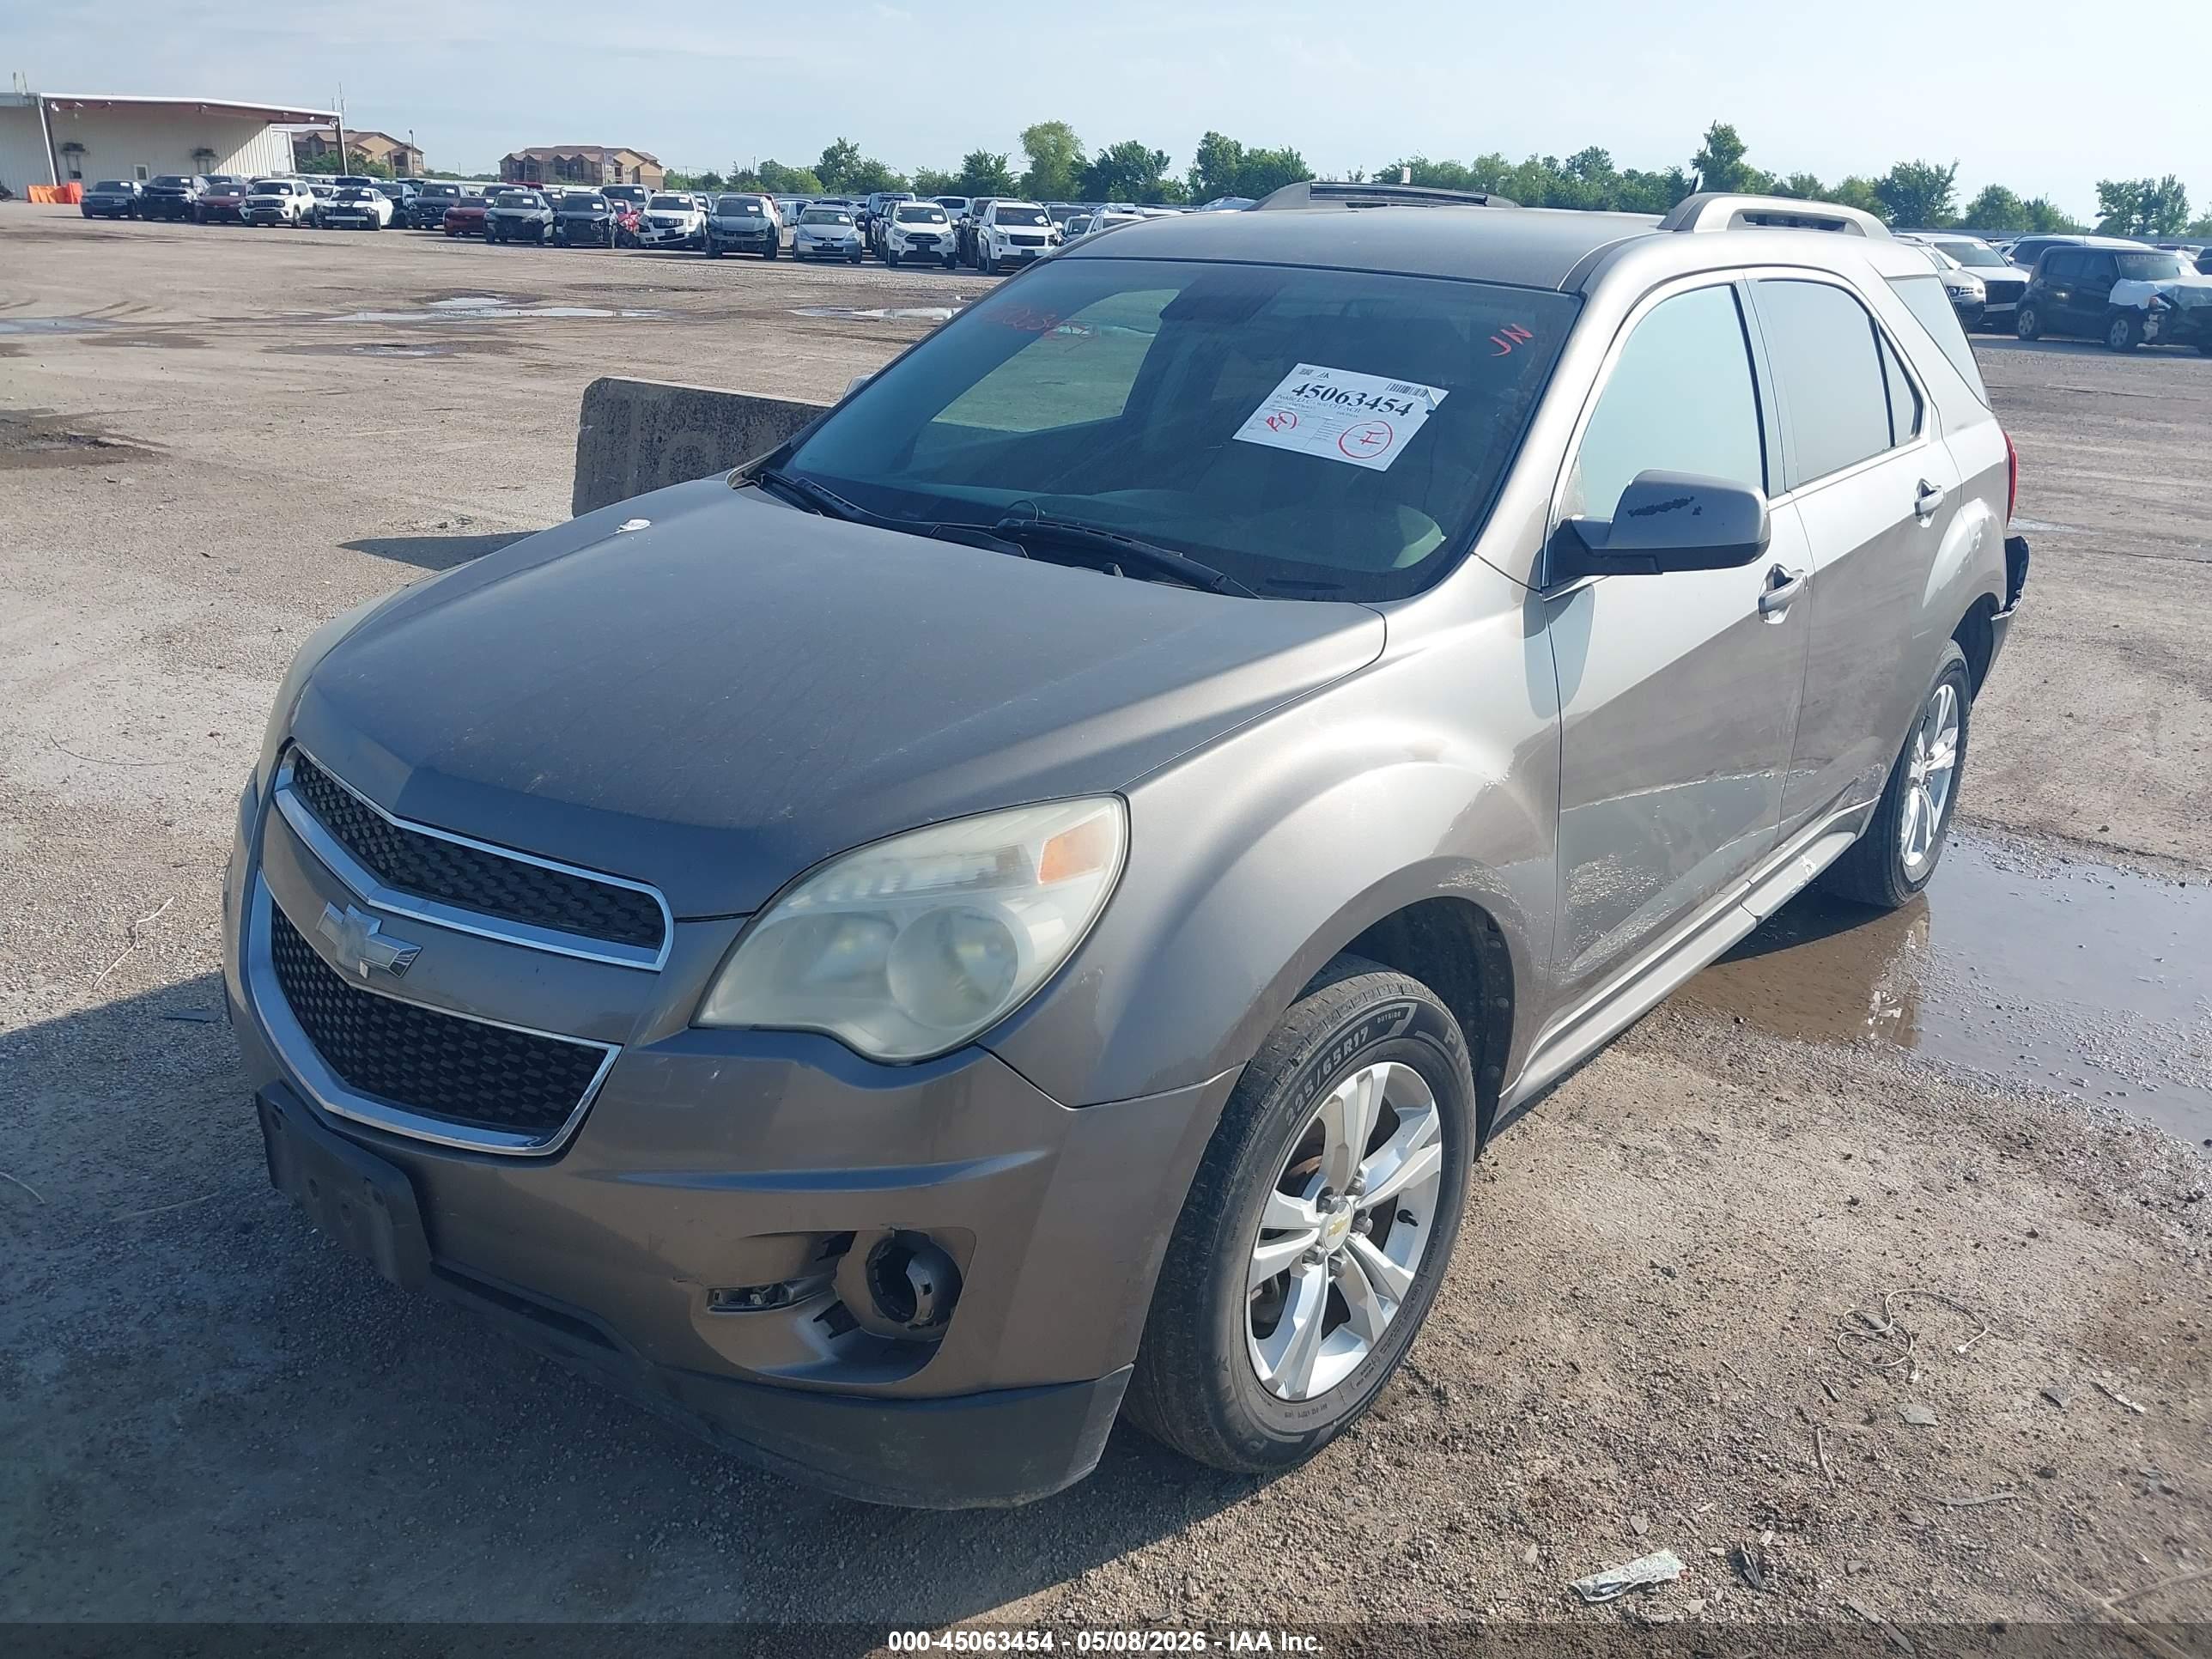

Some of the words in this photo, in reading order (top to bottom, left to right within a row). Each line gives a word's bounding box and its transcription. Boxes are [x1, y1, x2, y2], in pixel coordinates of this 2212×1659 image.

[1291, 382, 1415, 417] 45063454
[1376, 1011, 1401, 1024] OUTSIDE
[1285, 1026, 1369, 1127] 225/65R17
